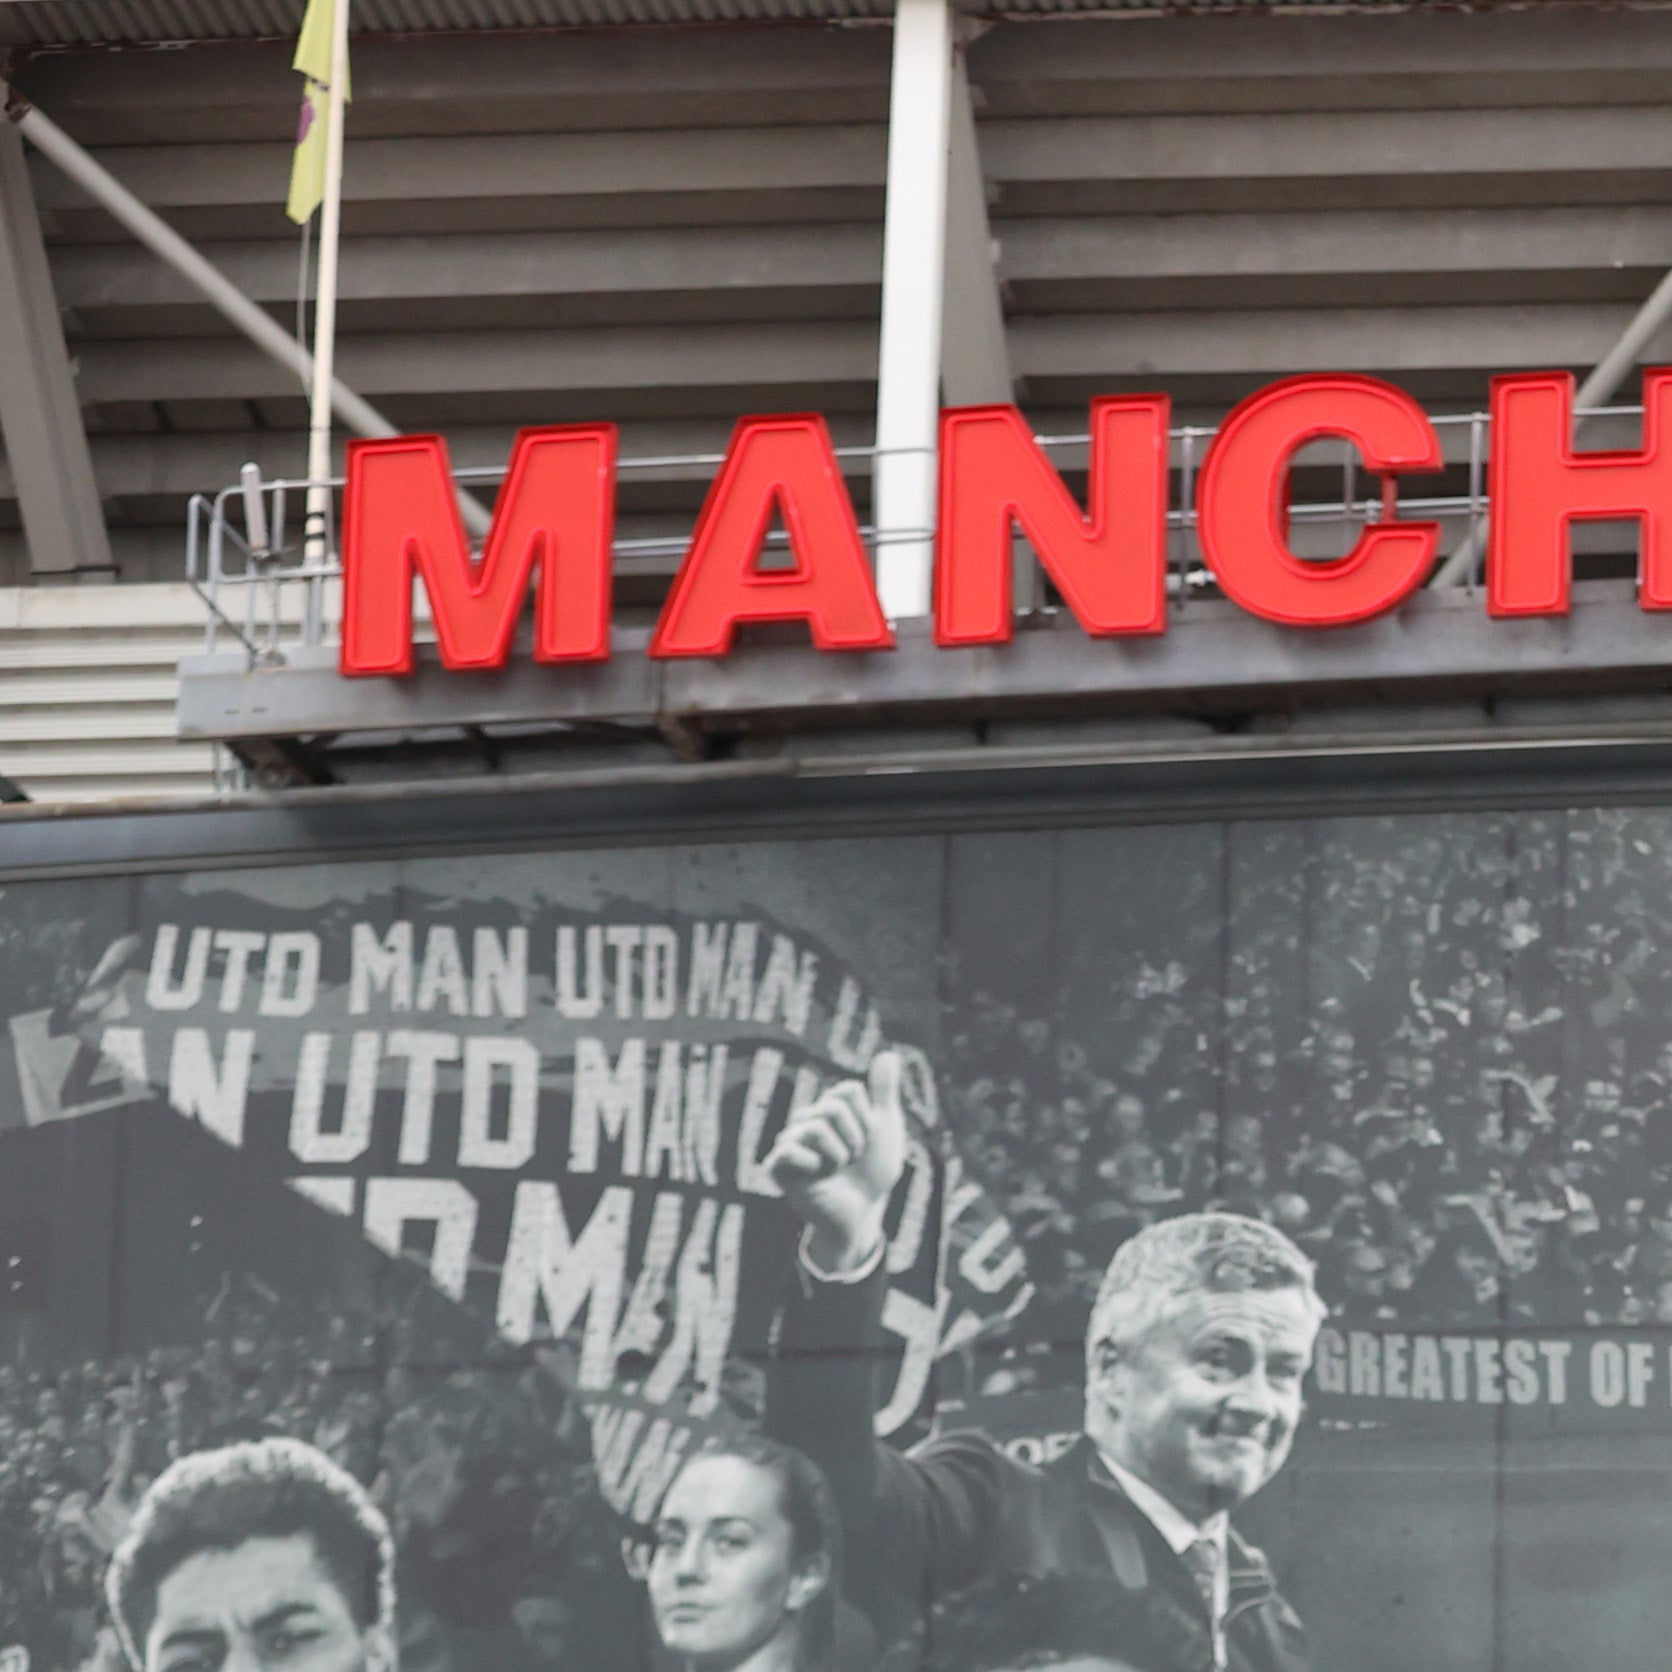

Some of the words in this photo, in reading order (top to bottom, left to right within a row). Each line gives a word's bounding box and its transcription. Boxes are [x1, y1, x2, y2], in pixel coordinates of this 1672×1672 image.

[147, 924, 320, 1016] UTD
[350, 922, 528, 1018] MAN
[556, 925, 676, 1018] UTD
[690, 922, 818, 1036] MAN
[288, 1030, 540, 1170] UTD
[567, 1038, 728, 1186] MAN
[1315, 1331, 1572, 1405] GREATEST
[1588, 1339, 1653, 1409] OF
